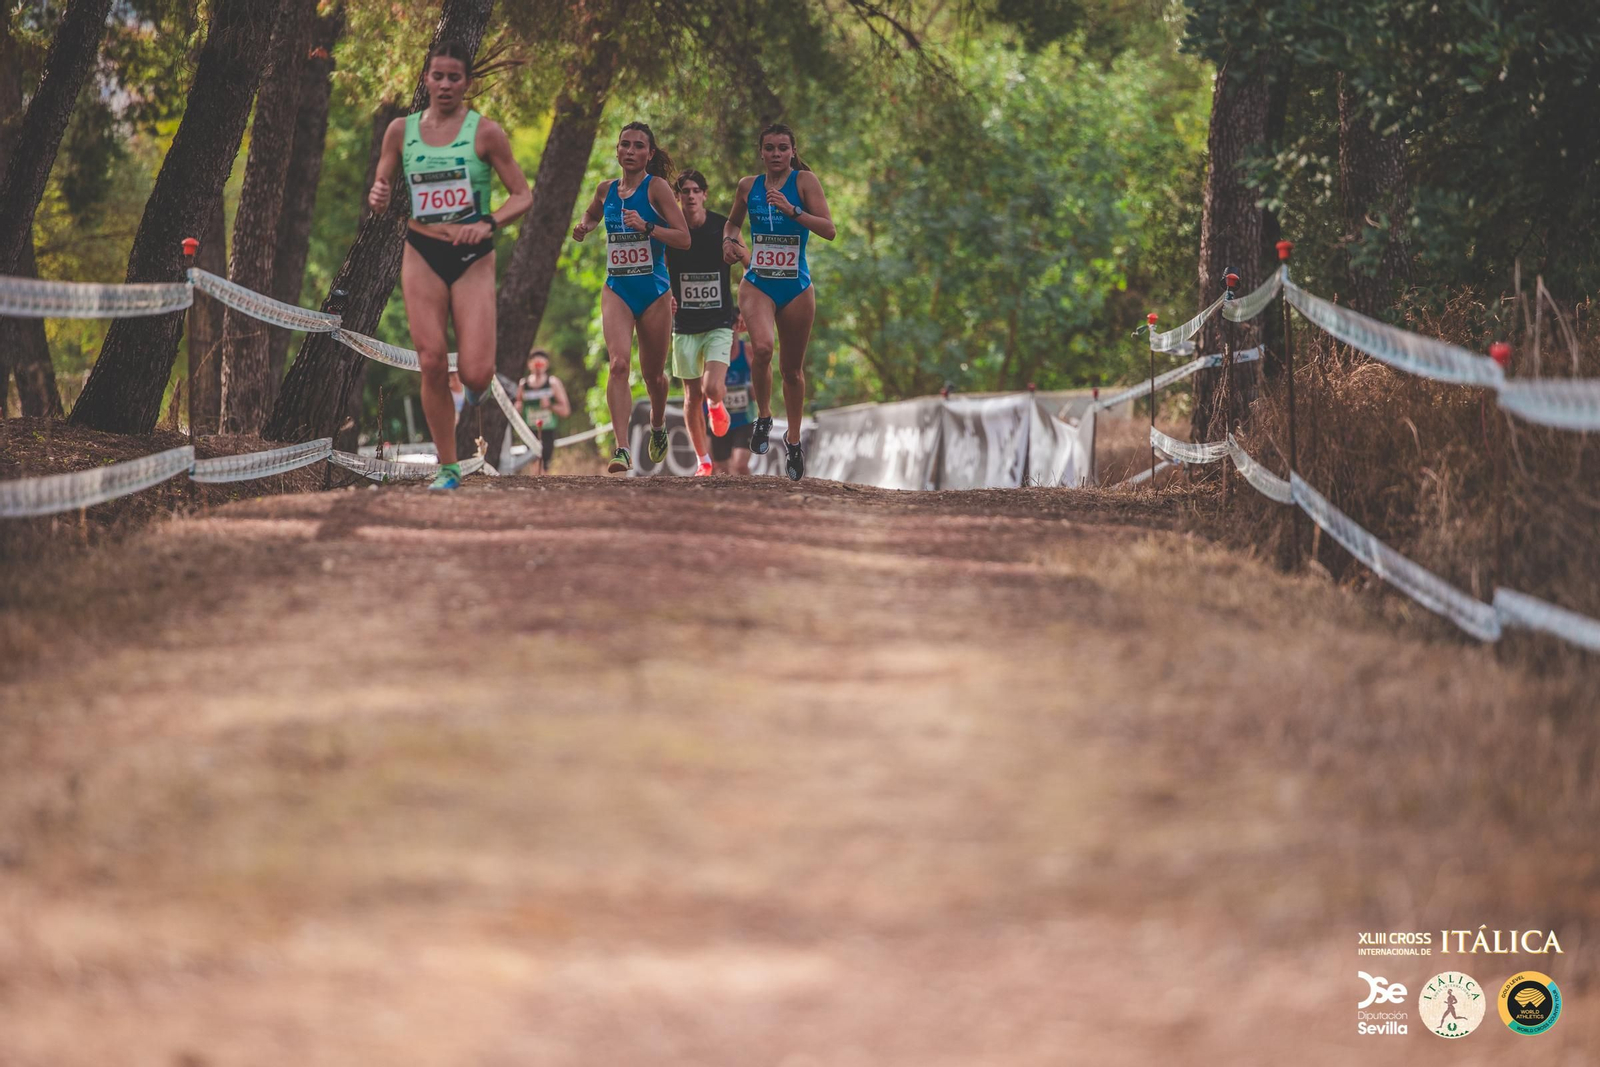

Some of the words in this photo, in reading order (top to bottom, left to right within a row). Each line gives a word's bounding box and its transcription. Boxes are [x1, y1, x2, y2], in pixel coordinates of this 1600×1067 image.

[418, 187, 470, 211] 7602
[611, 248, 650, 265] 6303
[756, 250, 796, 267] 6302
[684, 286, 718, 299] 6160
